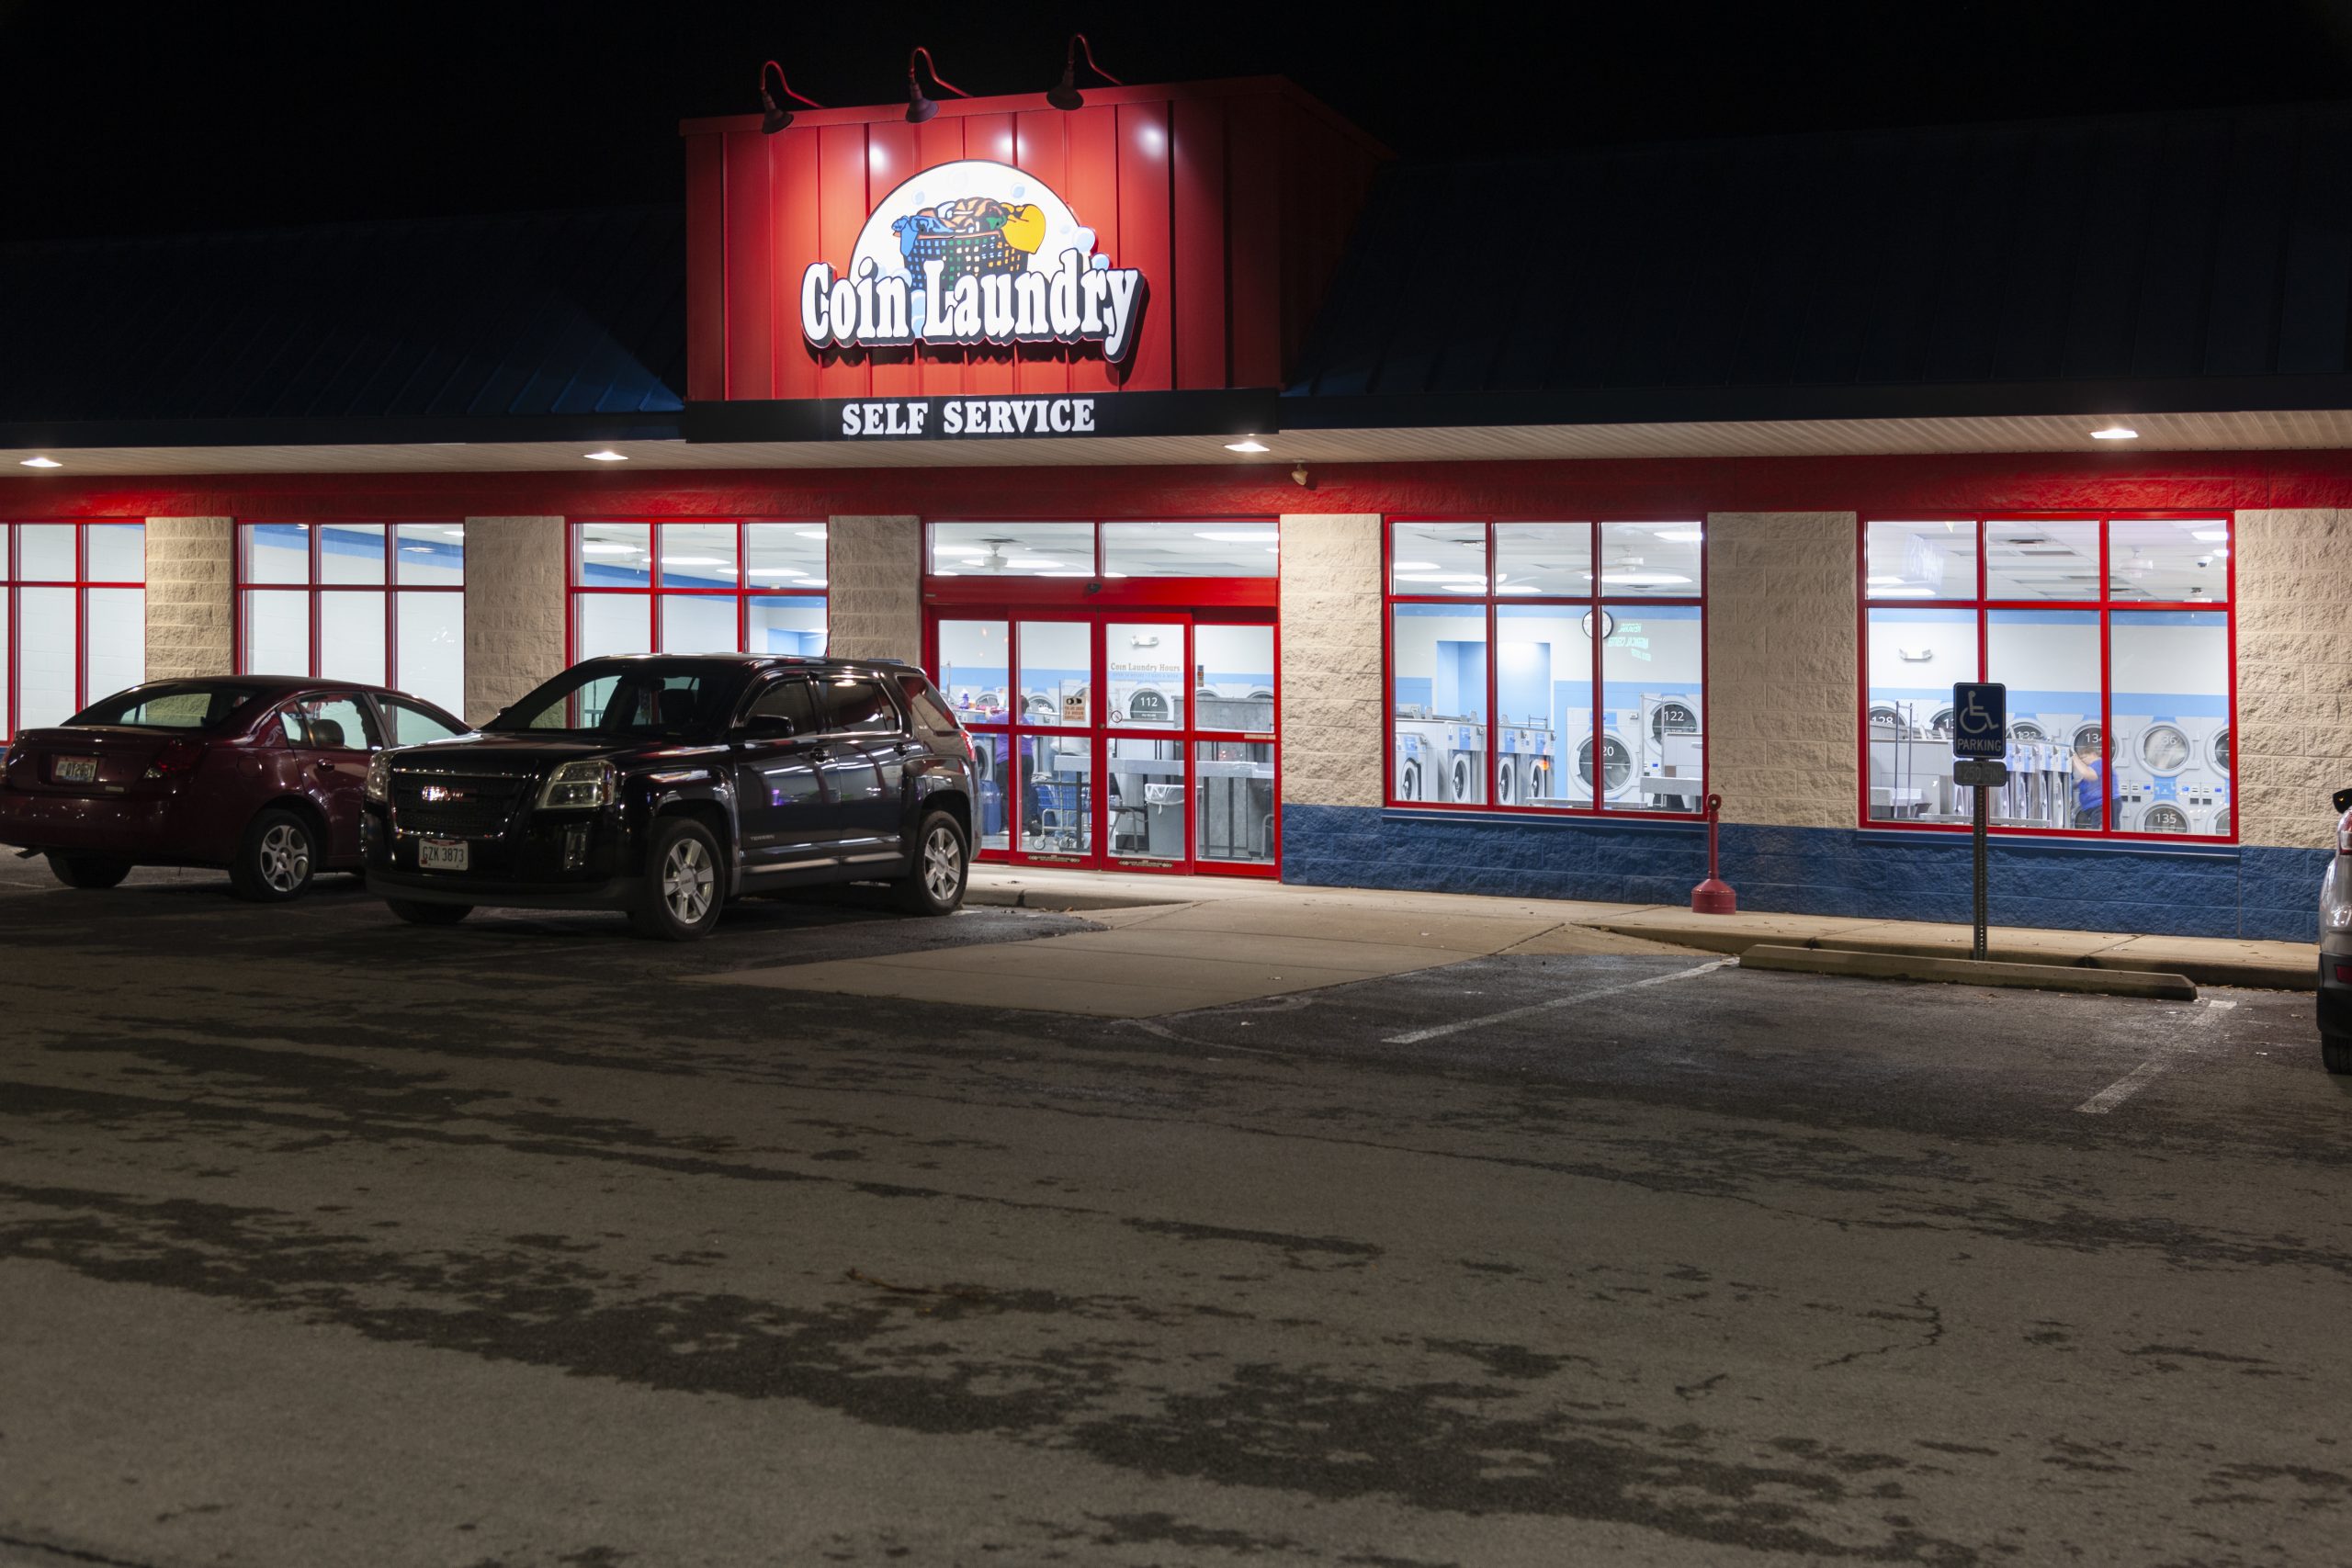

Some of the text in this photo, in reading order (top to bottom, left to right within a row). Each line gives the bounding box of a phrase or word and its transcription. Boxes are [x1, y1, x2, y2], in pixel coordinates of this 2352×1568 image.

[801, 247, 1140, 357] Coin Laundry
[842, 398, 1096, 436] SELF SERVICE
[1110, 662, 1181, 673] Coin Laundry Hours
[1140, 696, 1159, 707] 112
[1664, 710, 1685, 722] 122
[1957, 738, 2002, 752] PARKING
[2155, 813, 2177, 824] 135
[423, 846, 465, 863] GZK 3873
